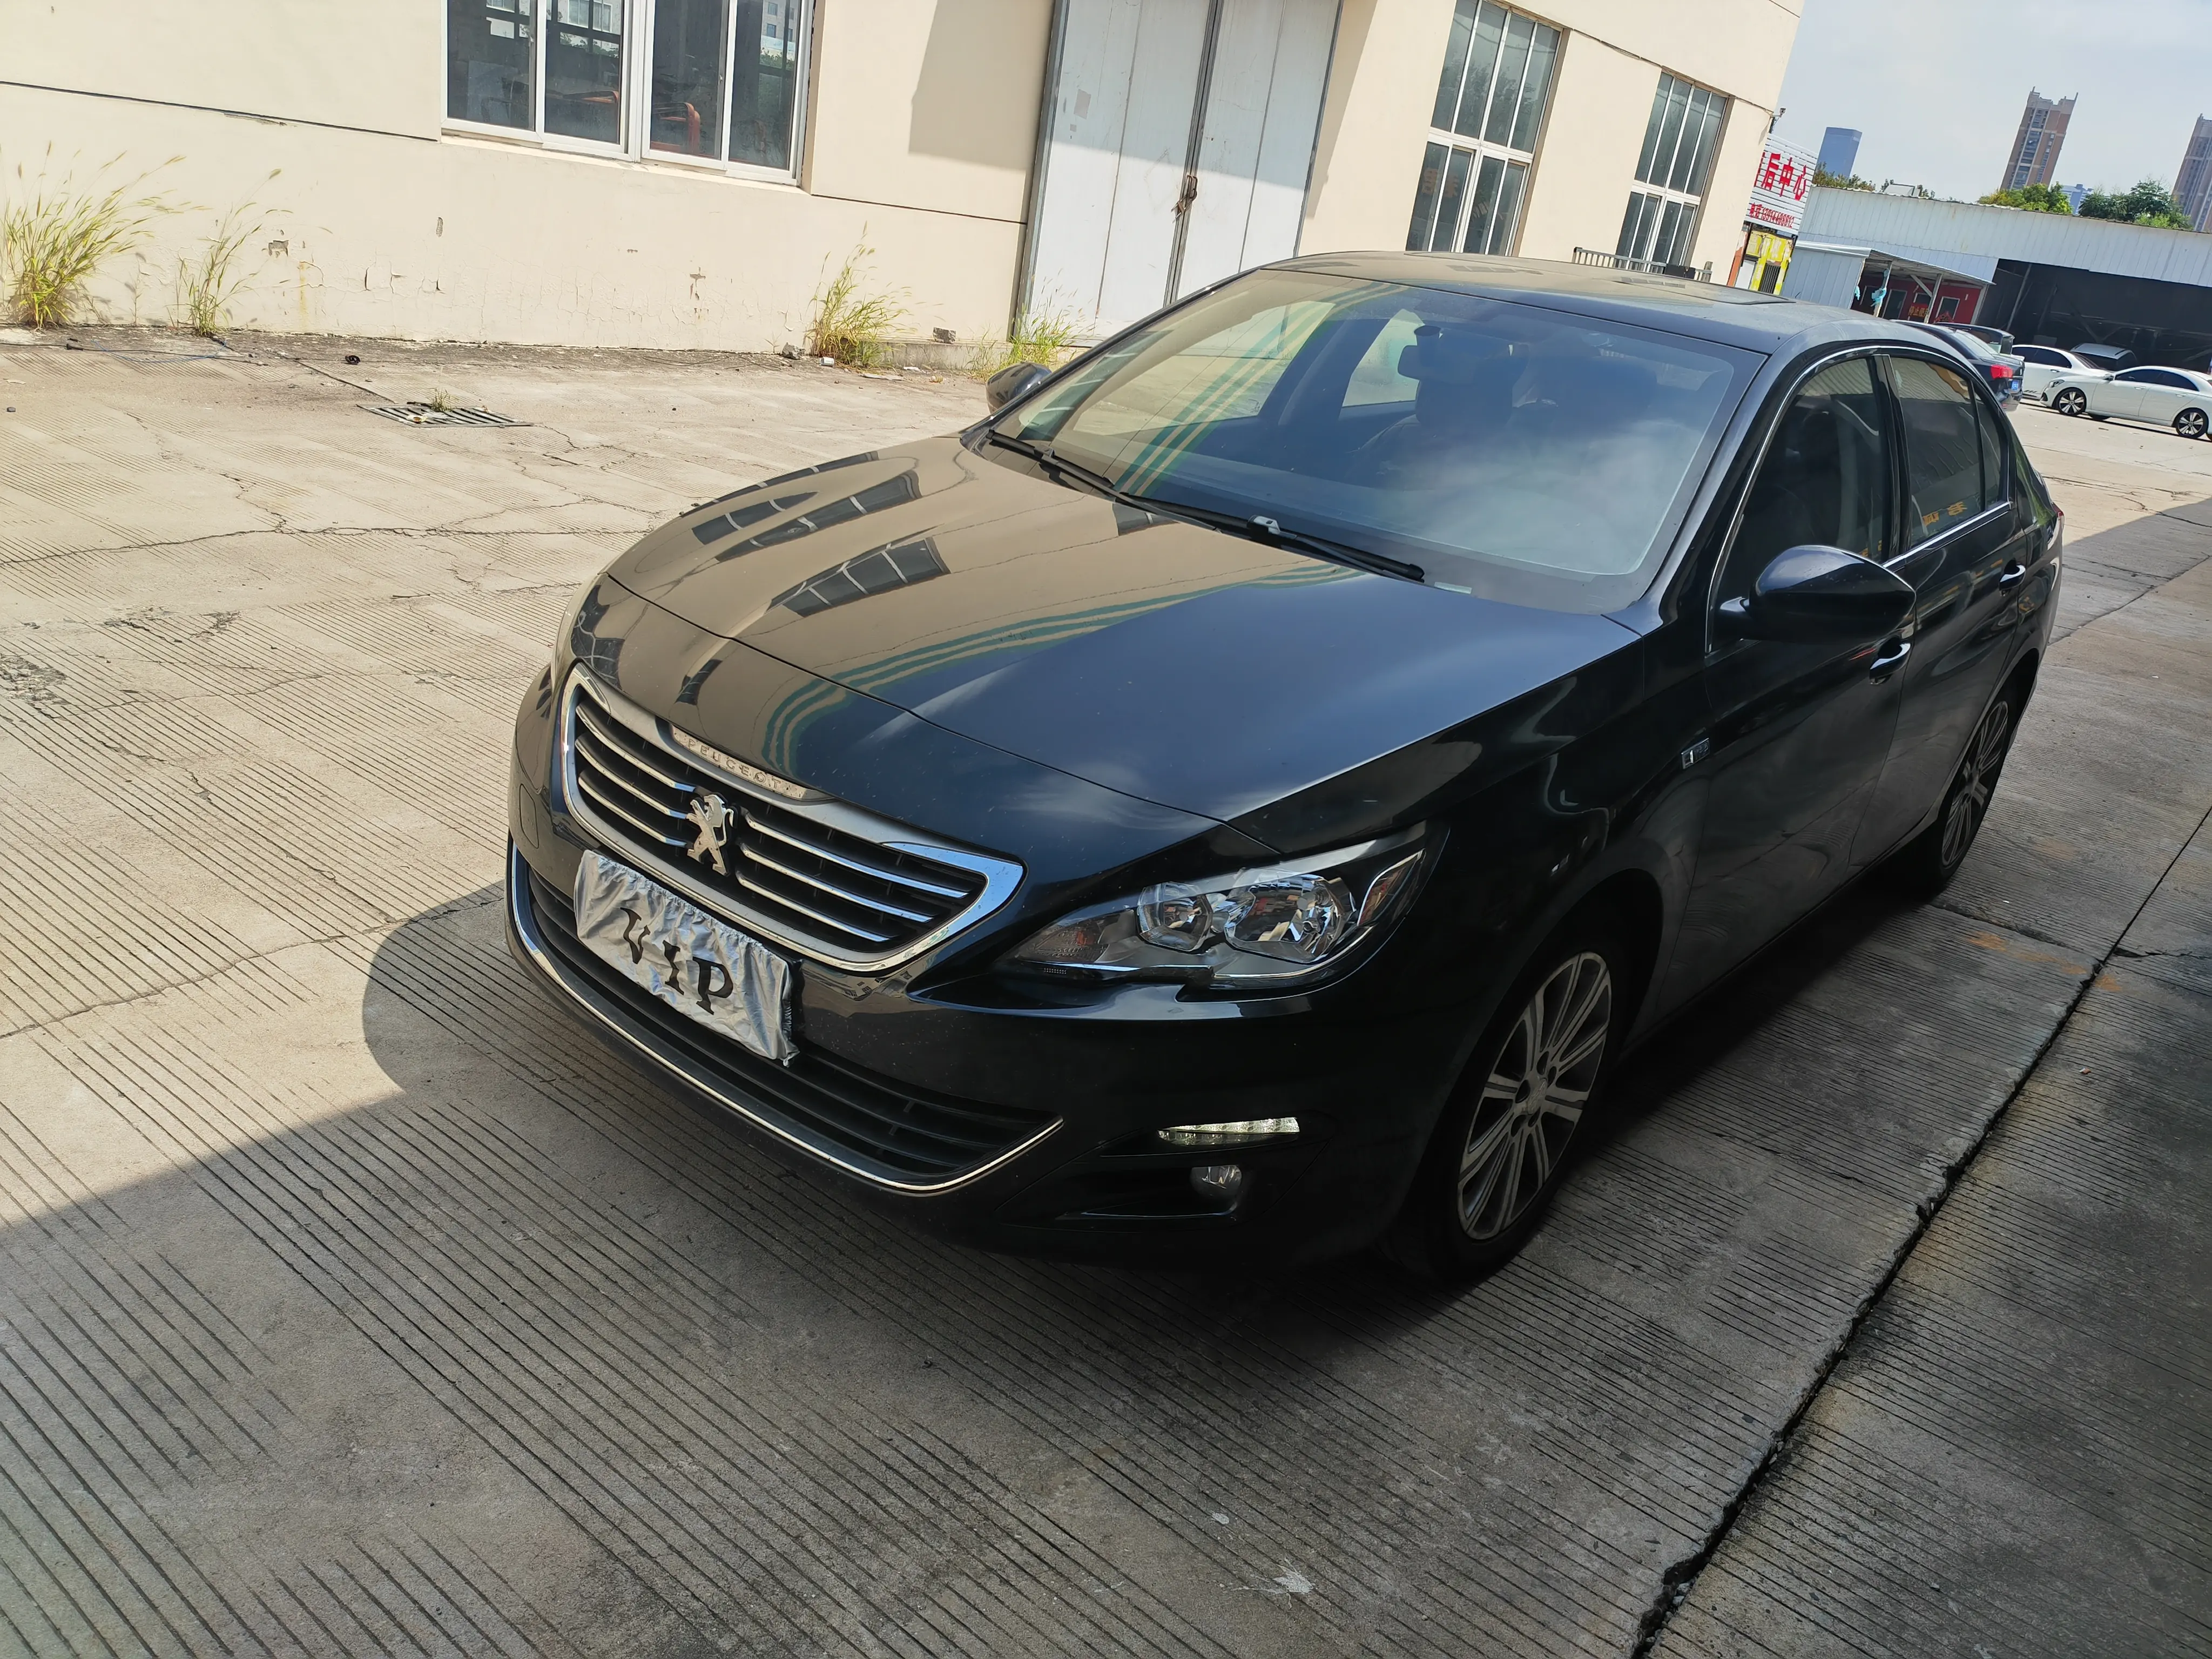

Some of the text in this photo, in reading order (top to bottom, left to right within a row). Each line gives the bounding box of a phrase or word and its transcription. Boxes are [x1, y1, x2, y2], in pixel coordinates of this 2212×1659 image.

[1754, 152, 1807, 201] 后中心
[687, 738, 781, 790] PEUGEOT
[619, 907, 734, 1015] VIP
